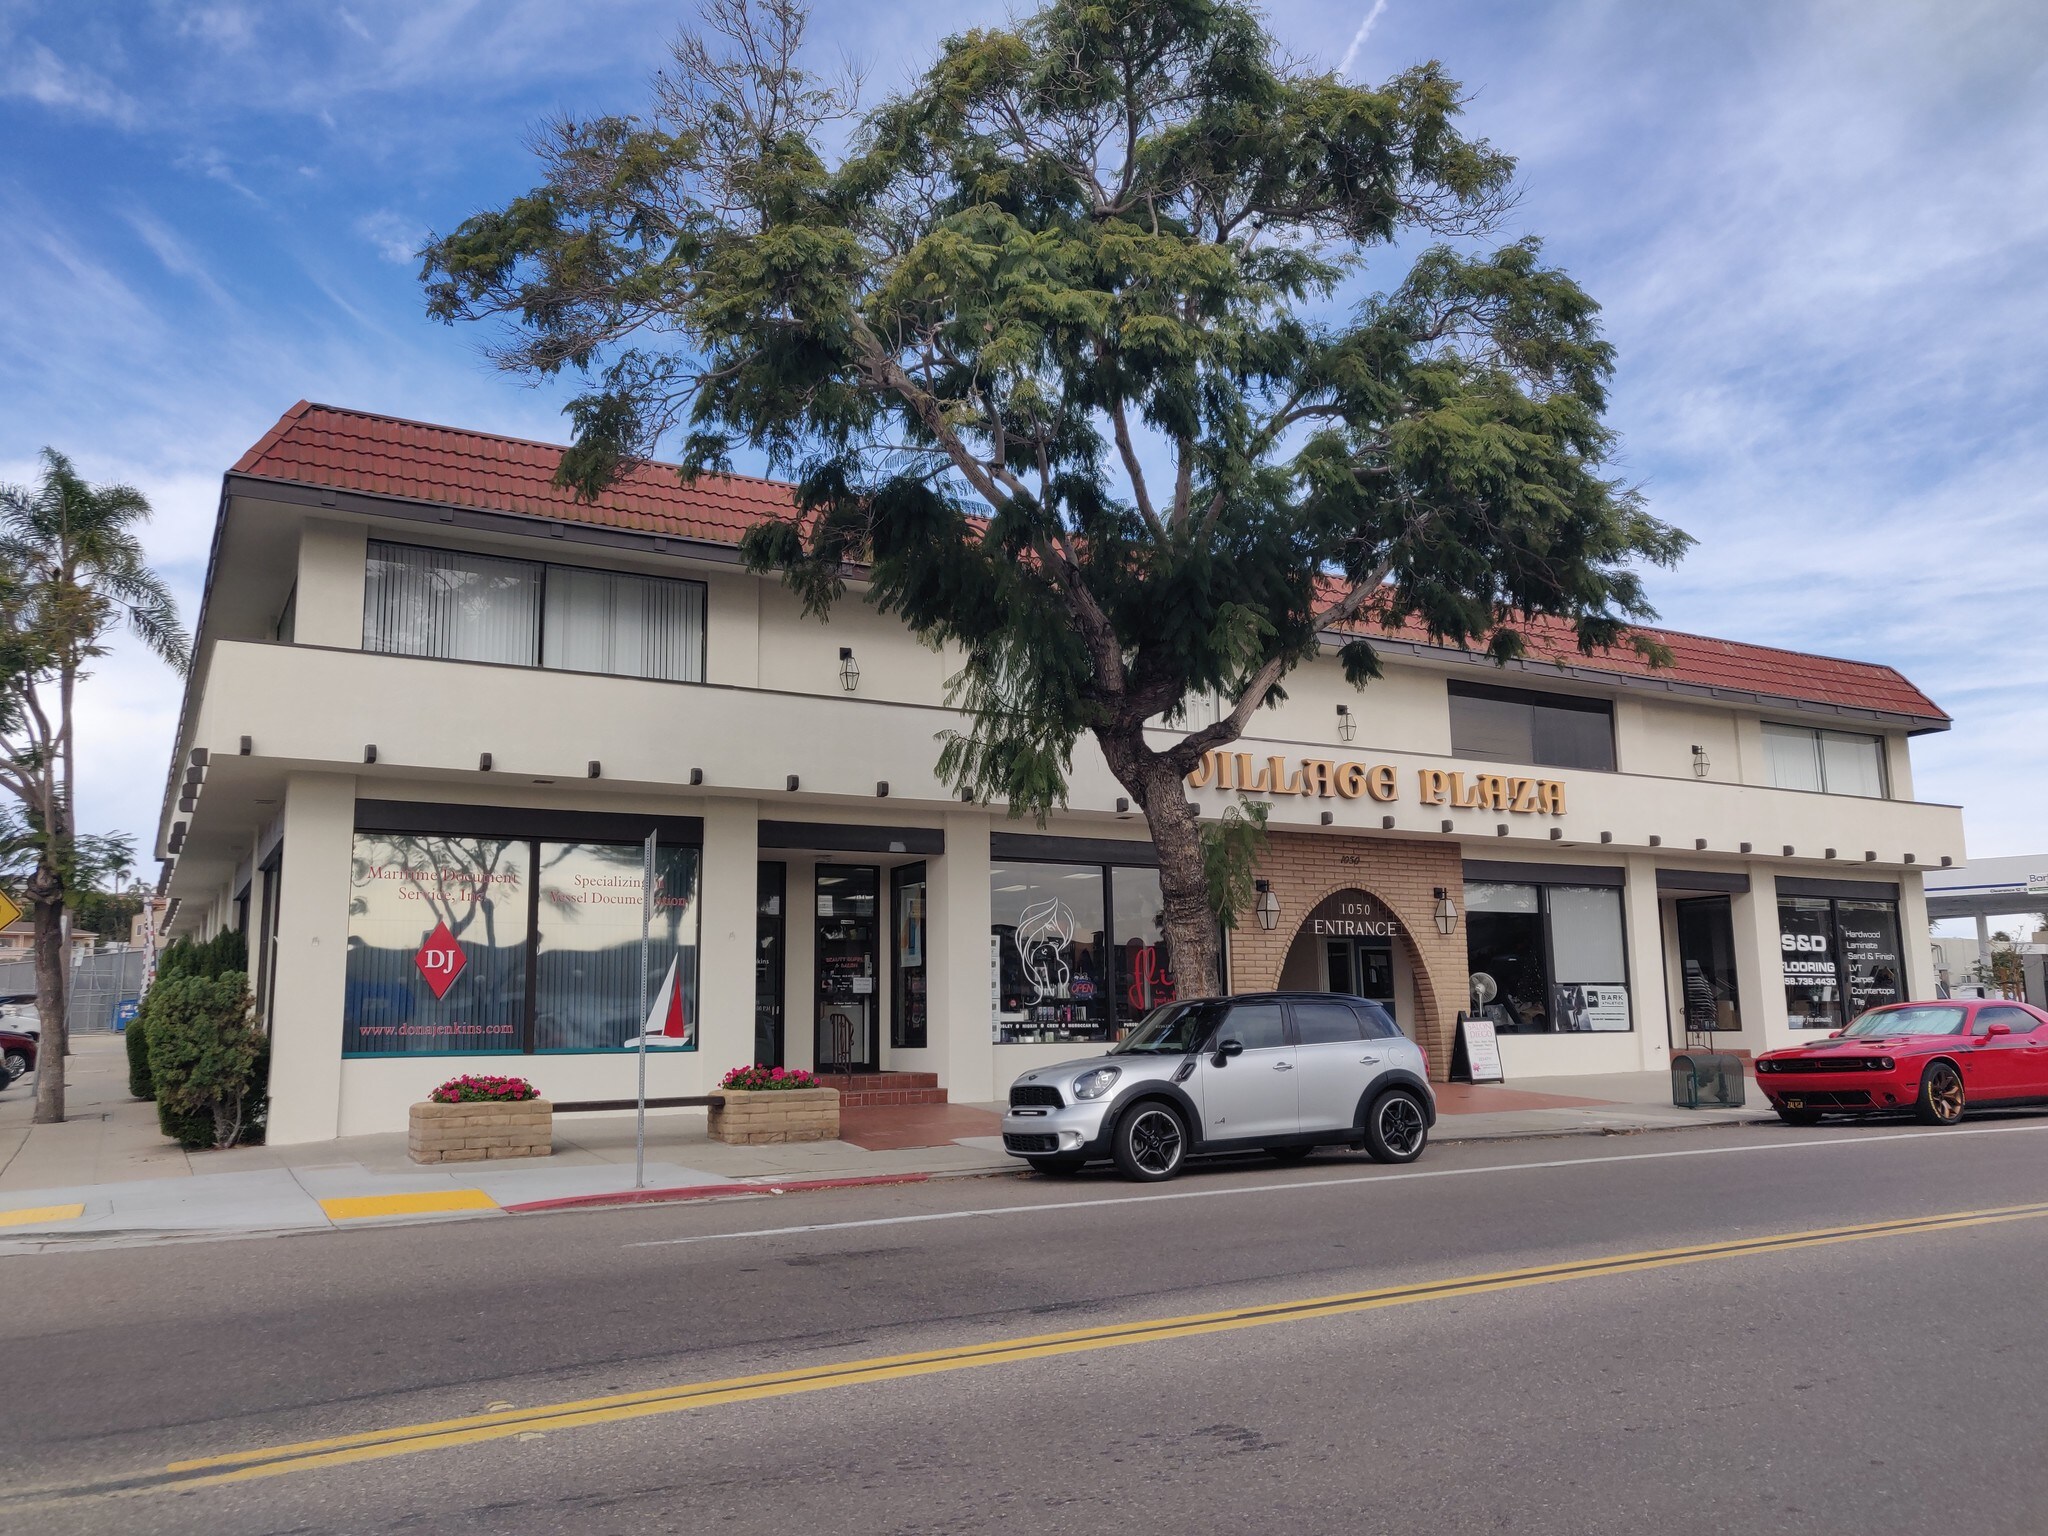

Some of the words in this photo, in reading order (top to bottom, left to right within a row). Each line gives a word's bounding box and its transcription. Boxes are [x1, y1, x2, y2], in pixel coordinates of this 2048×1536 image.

[1187, 750, 1399, 802] VILLAGE
[1418, 769, 1567, 816] PLAZA
[1340, 855, 1360, 864] 1050
[367, 866, 438, 881] Maritime
[442, 869, 518, 883] Document
[2029, 873, 2048, 883] Bar
[550, 891, 587, 903] Vessel
[1342, 903, 1371, 915] 1050
[1315, 920, 1397, 936] ENTRANCE
[1781, 934, 1827, 952] S&D
[1847, 952, 1866, 960] Sand
[1875, 952, 1896, 960] Finish
[425, 950, 456, 974] DJ
[1849, 964, 1862, 972] LVT
[1784, 977, 1837, 985] 58.736.4430
[1850, 975, 1875, 984] Carpet
[1071, 983, 1094, 994] OPEN
[1851, 986, 1896, 995] Countertops
[1852, 997, 1866, 1006] Tile
[359, 1022, 514, 1037] www.donajenkins.com
